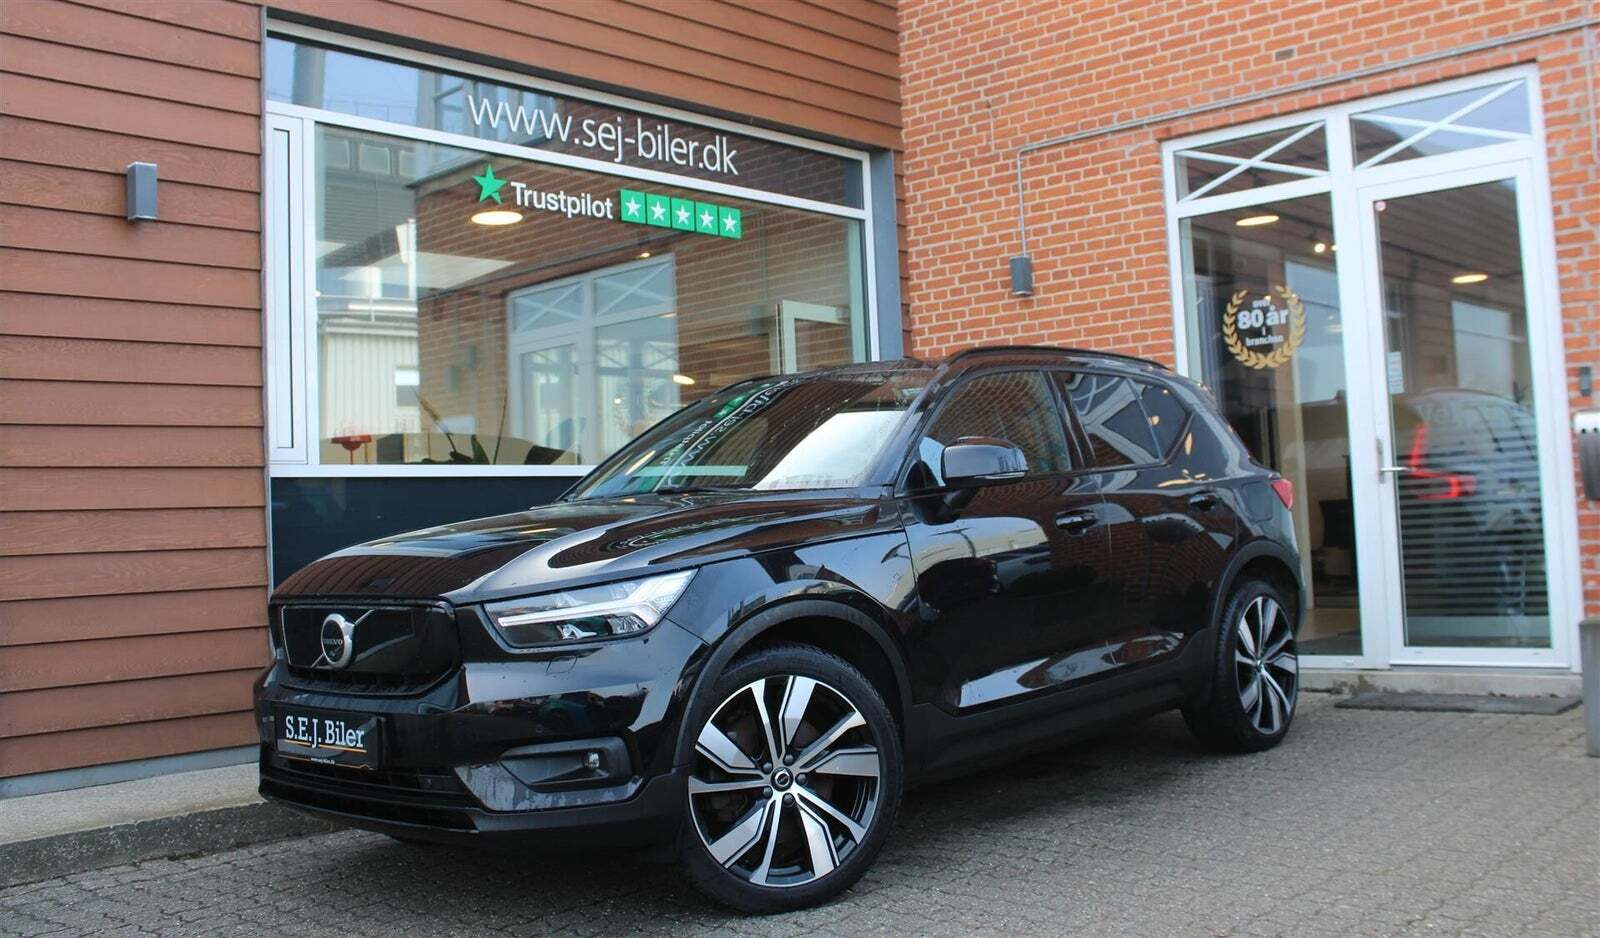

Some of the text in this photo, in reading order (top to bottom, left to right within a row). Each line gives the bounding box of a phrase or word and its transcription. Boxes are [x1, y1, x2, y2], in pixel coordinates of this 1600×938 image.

[468, 95, 739, 175] www.sej-biler.dk
[510, 181, 614, 219] Trustpilot
[1237, 304, 1289, 330] 80 år
[285, 715, 365, 749] S.E.J. Biler
